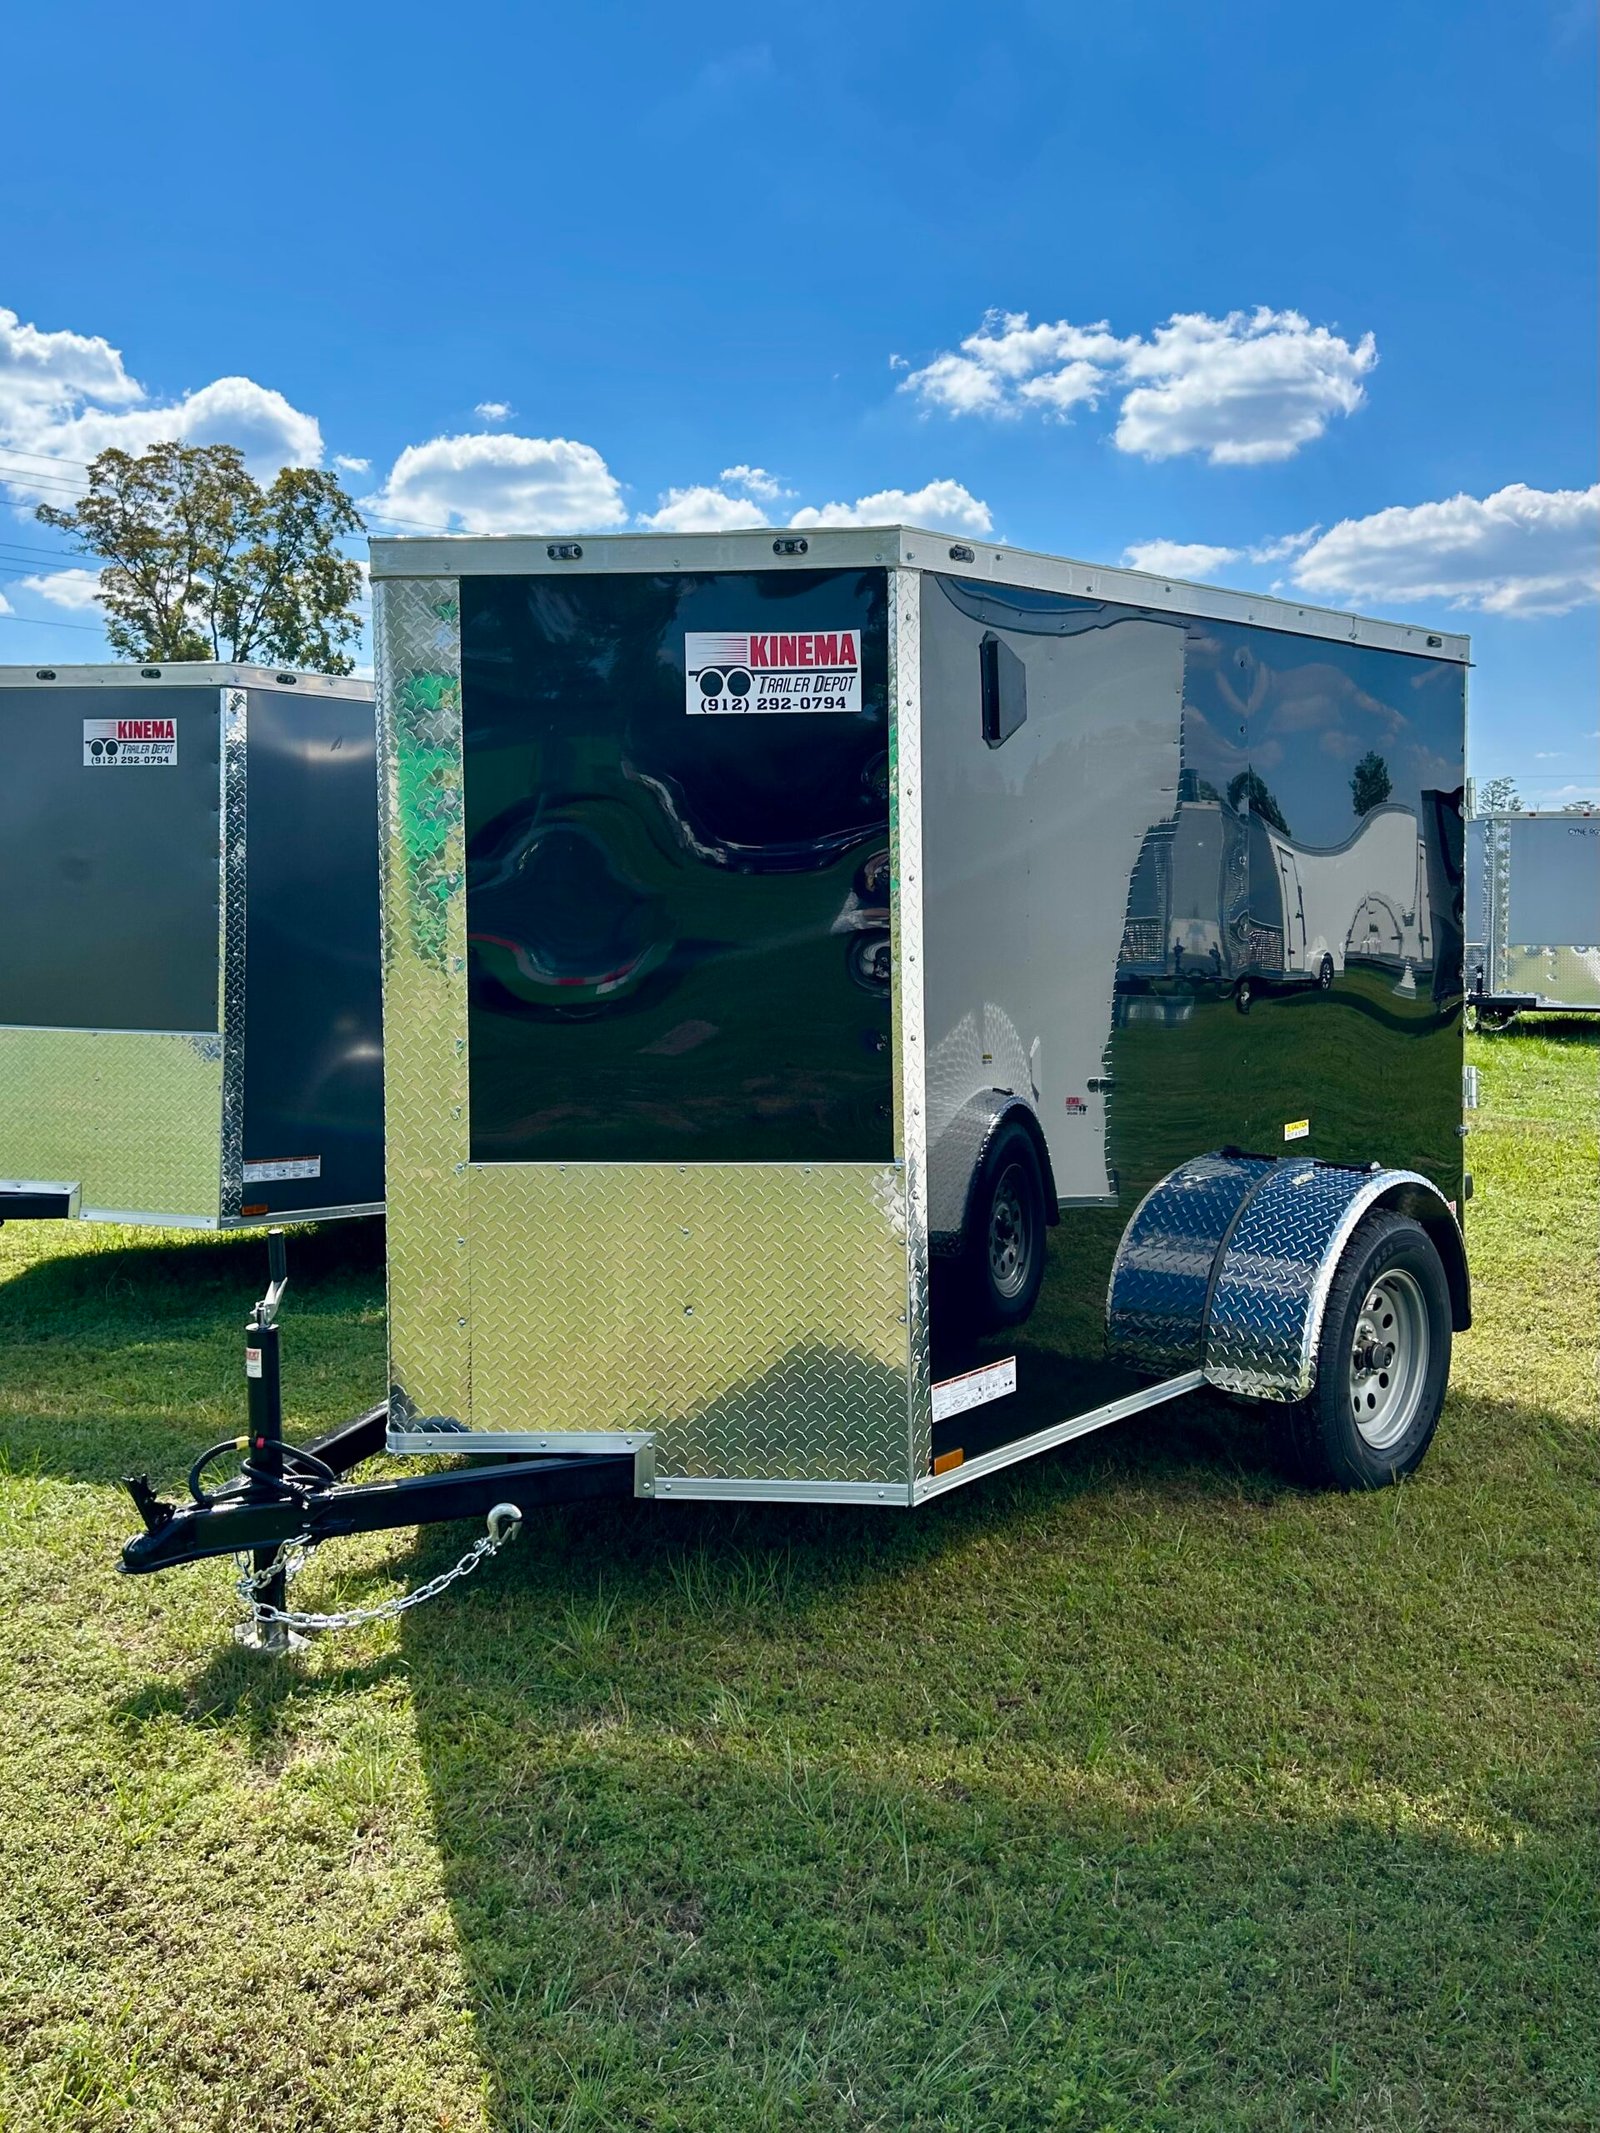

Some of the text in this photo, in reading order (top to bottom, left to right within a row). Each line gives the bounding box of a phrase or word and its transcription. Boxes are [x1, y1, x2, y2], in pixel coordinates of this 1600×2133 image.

[750, 633, 857, 667] KINEMA
[759, 675, 856, 694] TRAILER DEPOT
[701, 697, 846, 713] (912) 292-0794
[118, 720, 175, 739] KINEMA
[122, 743, 174, 755] TRAILER DEPOT
[91, 756, 169, 765] (912) 292-0794
